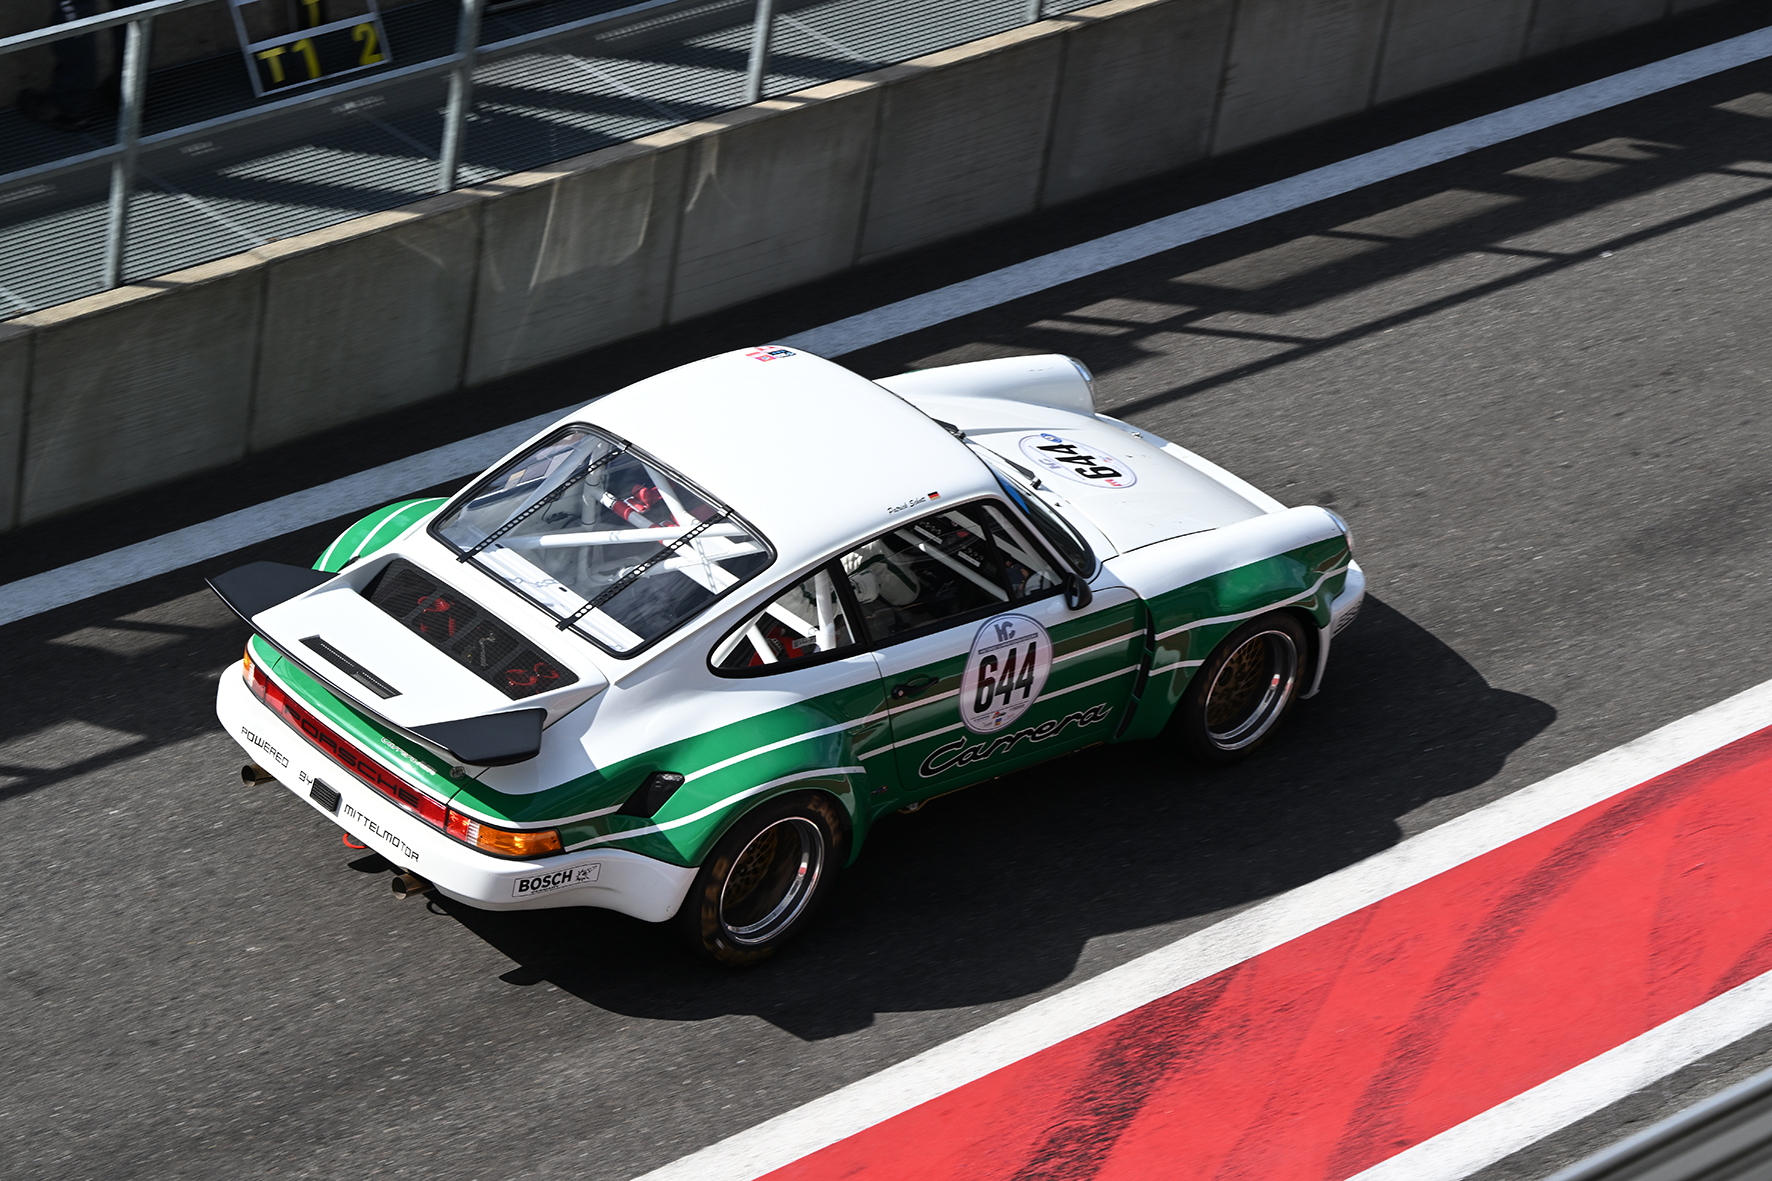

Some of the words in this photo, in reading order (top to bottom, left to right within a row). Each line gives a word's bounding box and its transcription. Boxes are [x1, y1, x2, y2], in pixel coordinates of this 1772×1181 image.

[257, 38, 321, 84] T1
[352, 22, 384, 66] 2
[1036, 443, 1123, 480] 644
[974, 641, 1037, 714] 644
[283, 703, 420, 809] PORSCHE
[918, 702, 1114, 779] Carrera
[240, 726, 290, 769] POWERED
[298, 770, 313, 786] BY
[343, 803, 420, 863] MITTELMOTOR
[518, 869, 573, 893] BOSCH
